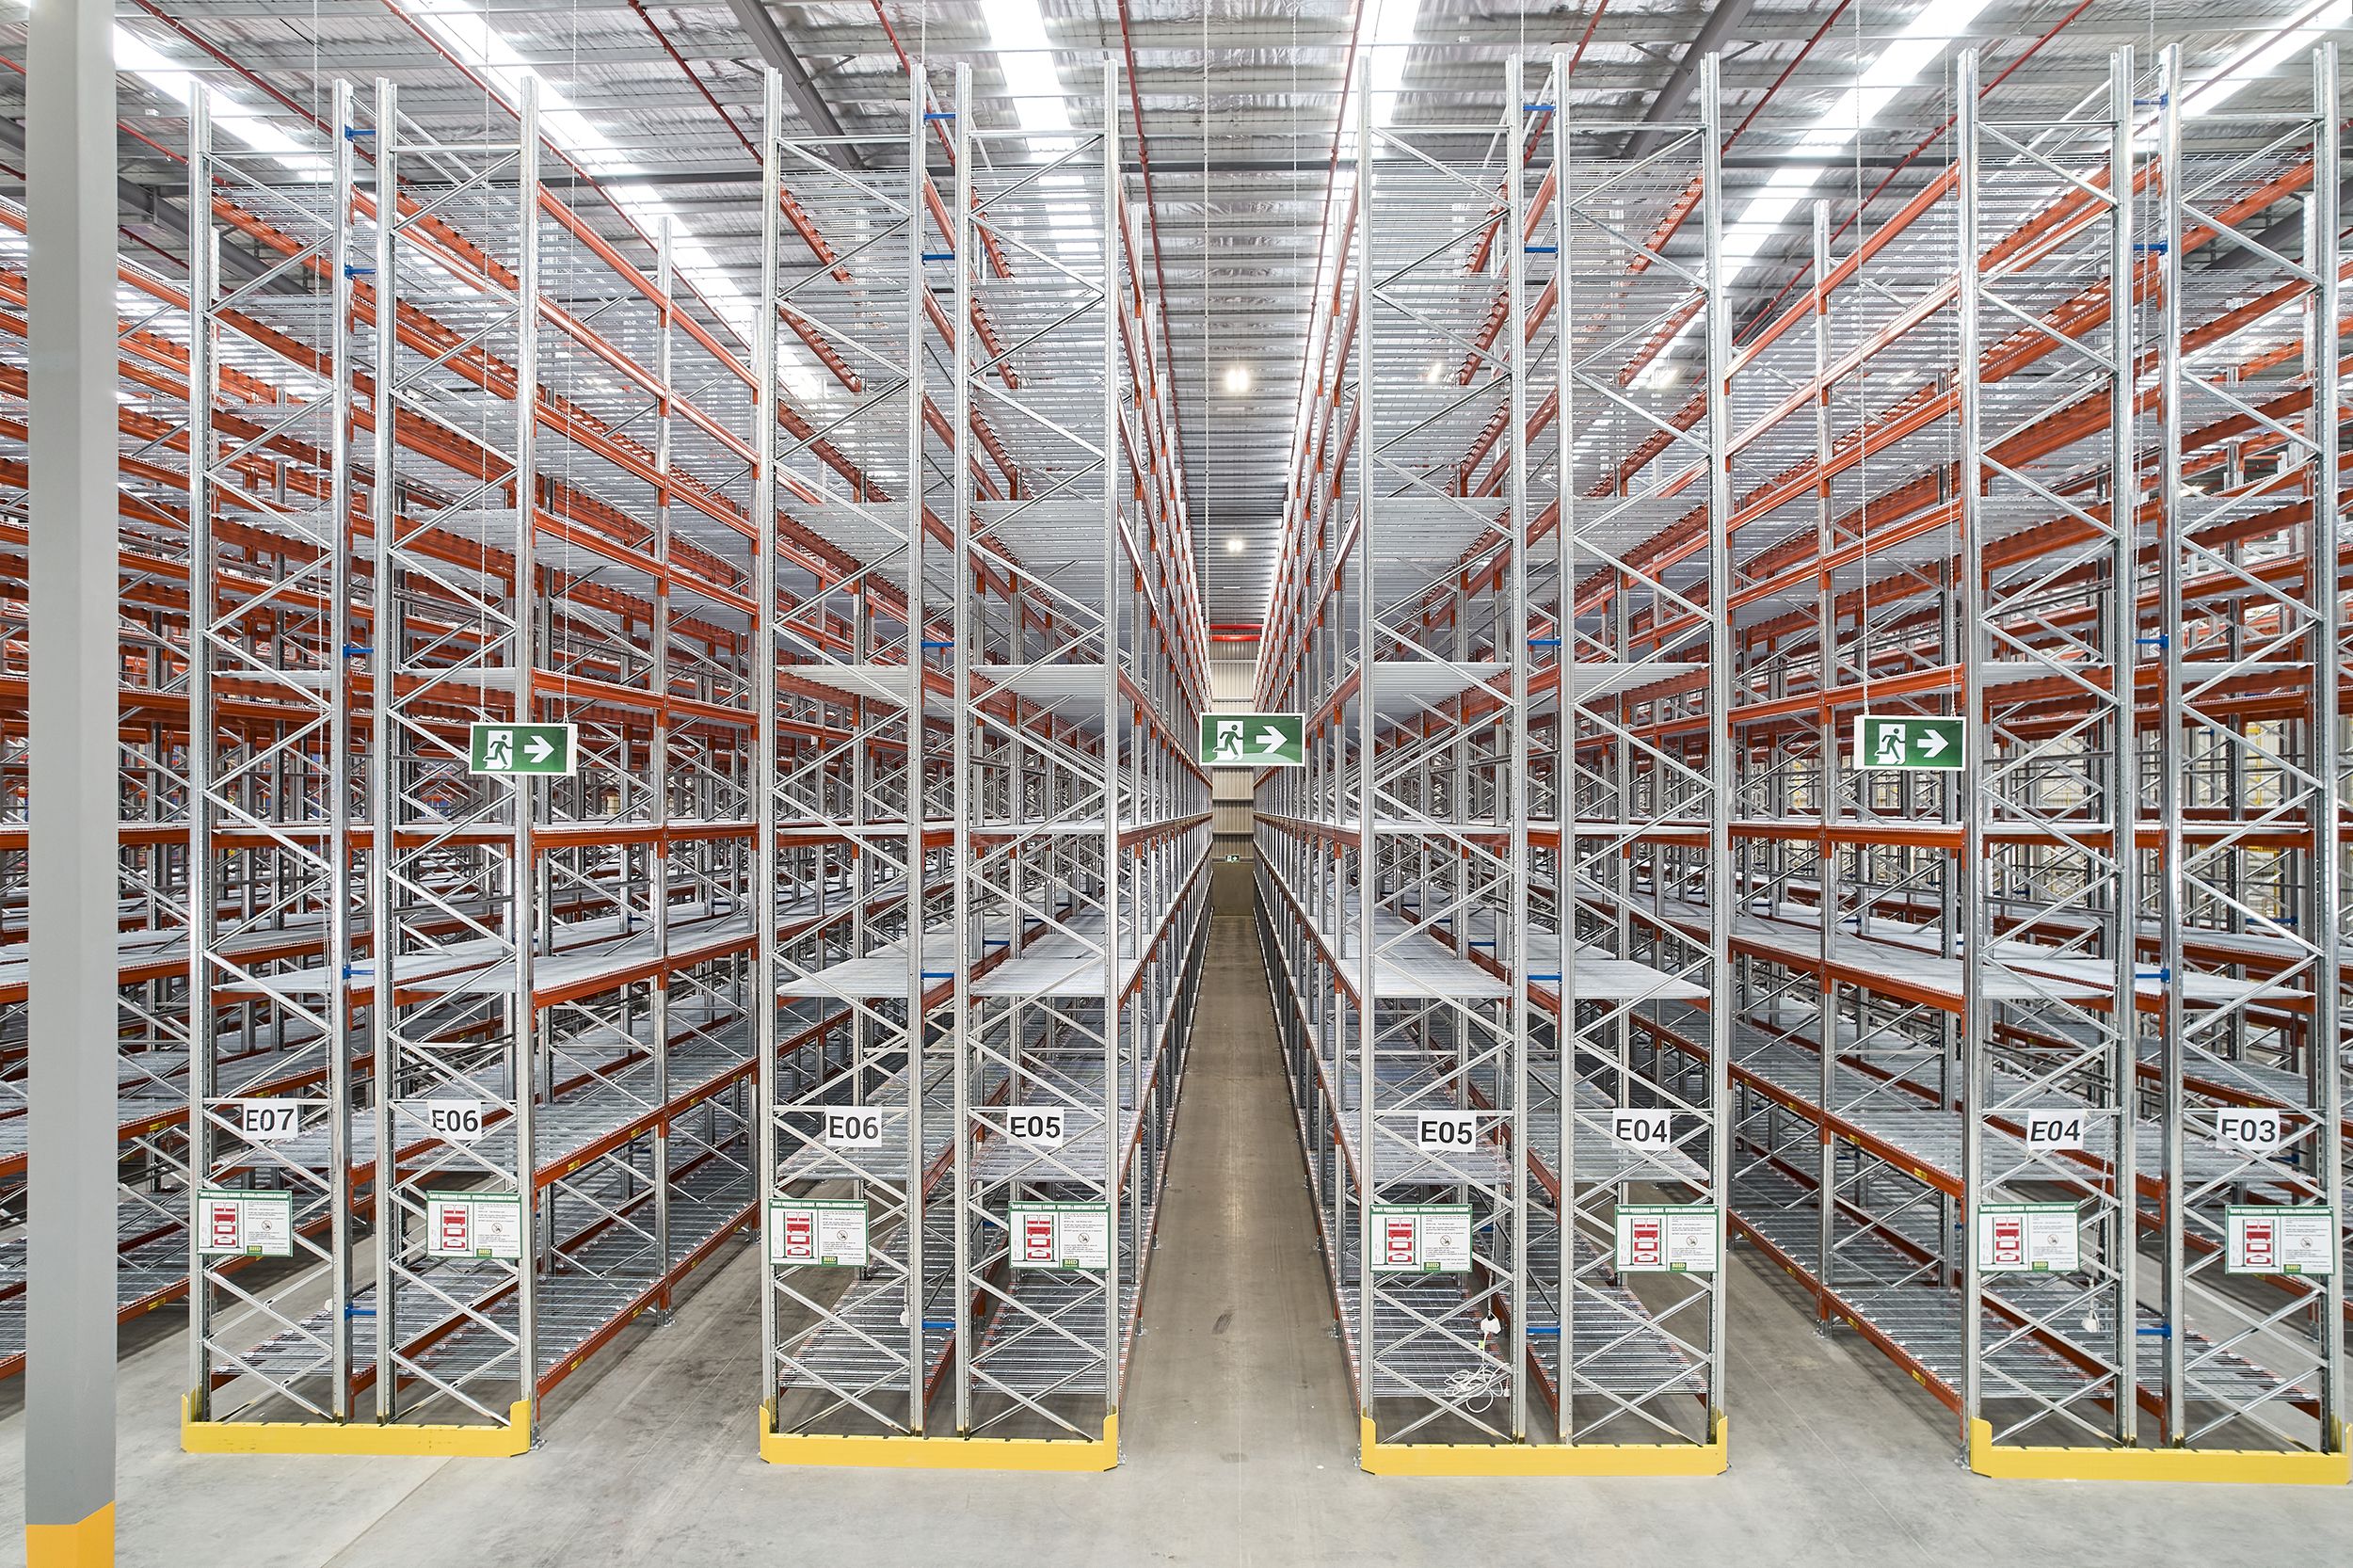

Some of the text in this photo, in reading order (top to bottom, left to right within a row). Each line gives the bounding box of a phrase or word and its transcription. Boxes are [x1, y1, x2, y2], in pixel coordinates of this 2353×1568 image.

[246, 1109, 294, 1131] E07
[432, 1110, 478, 1132] E06
[829, 1116, 878, 1139] E06
[1010, 1116, 1060, 1138] E05
[1616, 1119, 1667, 1143] E04
[2030, 1119, 2080, 1142] E04
[2221, 1119, 2276, 1143] E03
[1421, 1121, 1472, 1144] E05
